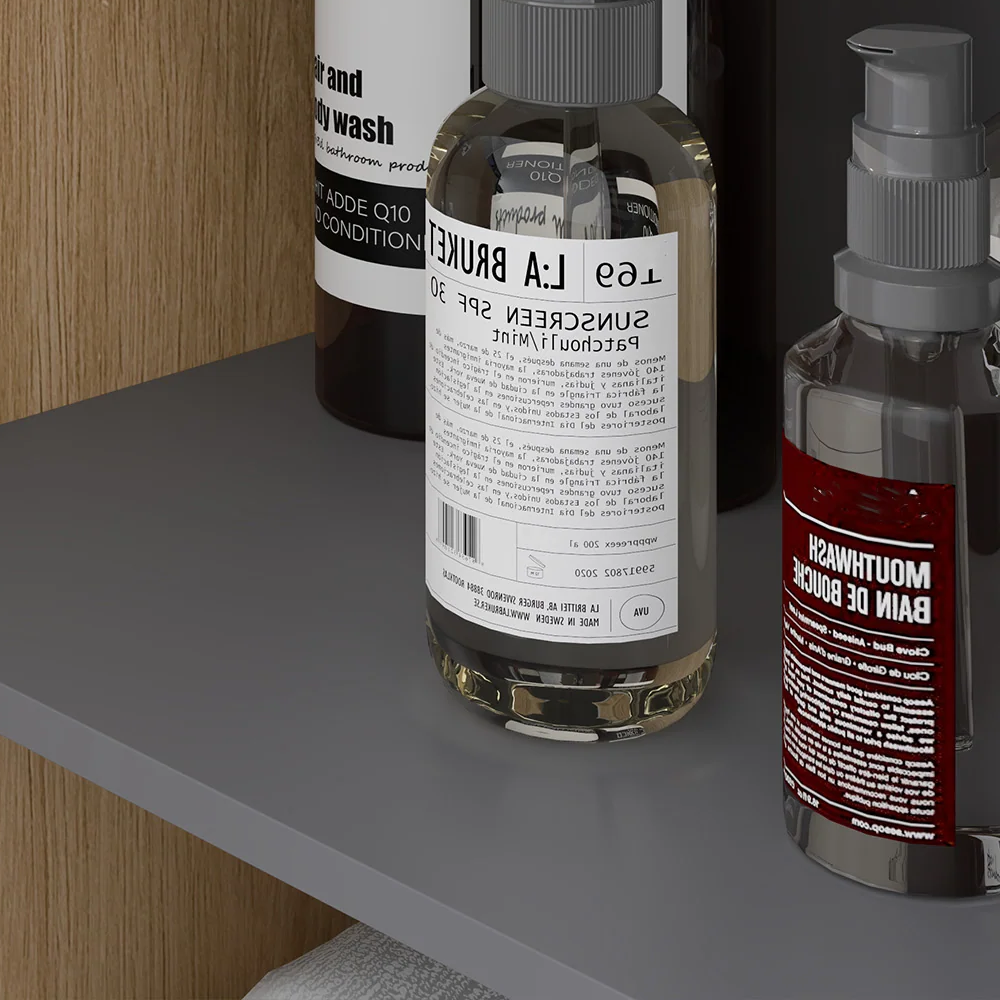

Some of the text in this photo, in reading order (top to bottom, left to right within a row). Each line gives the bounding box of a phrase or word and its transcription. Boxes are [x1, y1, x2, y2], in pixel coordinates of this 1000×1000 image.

[327, 65, 362, 98] and
[333, 109, 394, 145] wash
[326, 142, 428, 173] bathroom prod
[326, 188, 368, 218] ADDE
[373, 202, 411, 224] Q10
[322, 211, 421, 251] CONDITION
